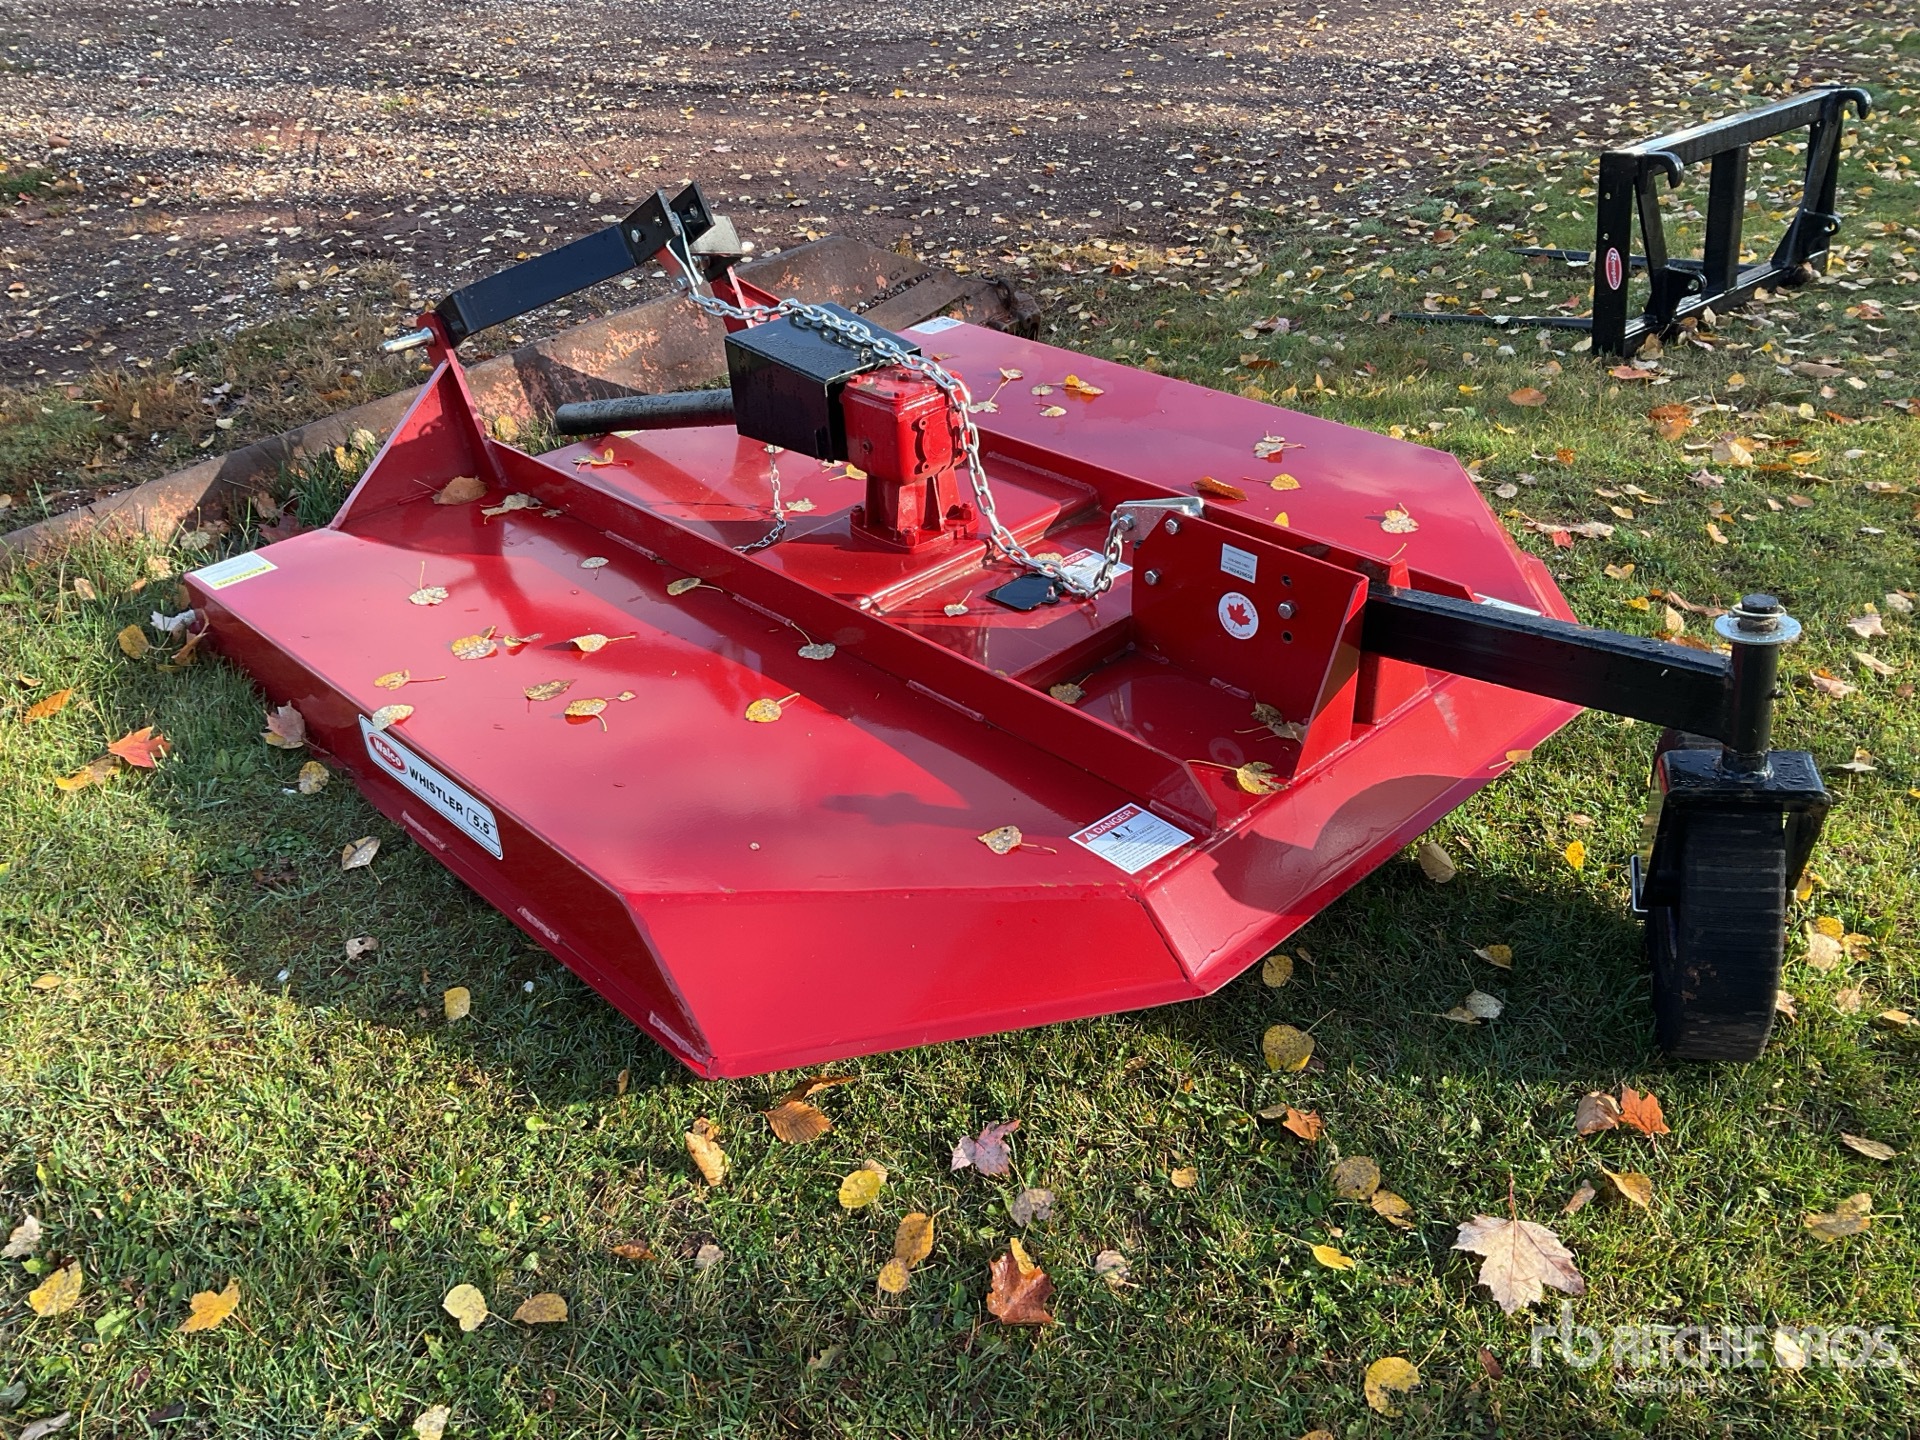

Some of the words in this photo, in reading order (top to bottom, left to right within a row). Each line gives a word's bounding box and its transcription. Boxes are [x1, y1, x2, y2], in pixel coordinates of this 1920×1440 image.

[373, 736, 402, 768] Walco
[408, 765, 464, 816] WHISTLER
[472, 814, 490, 835] 5.5
[1092, 809, 1135, 835] DANGER
